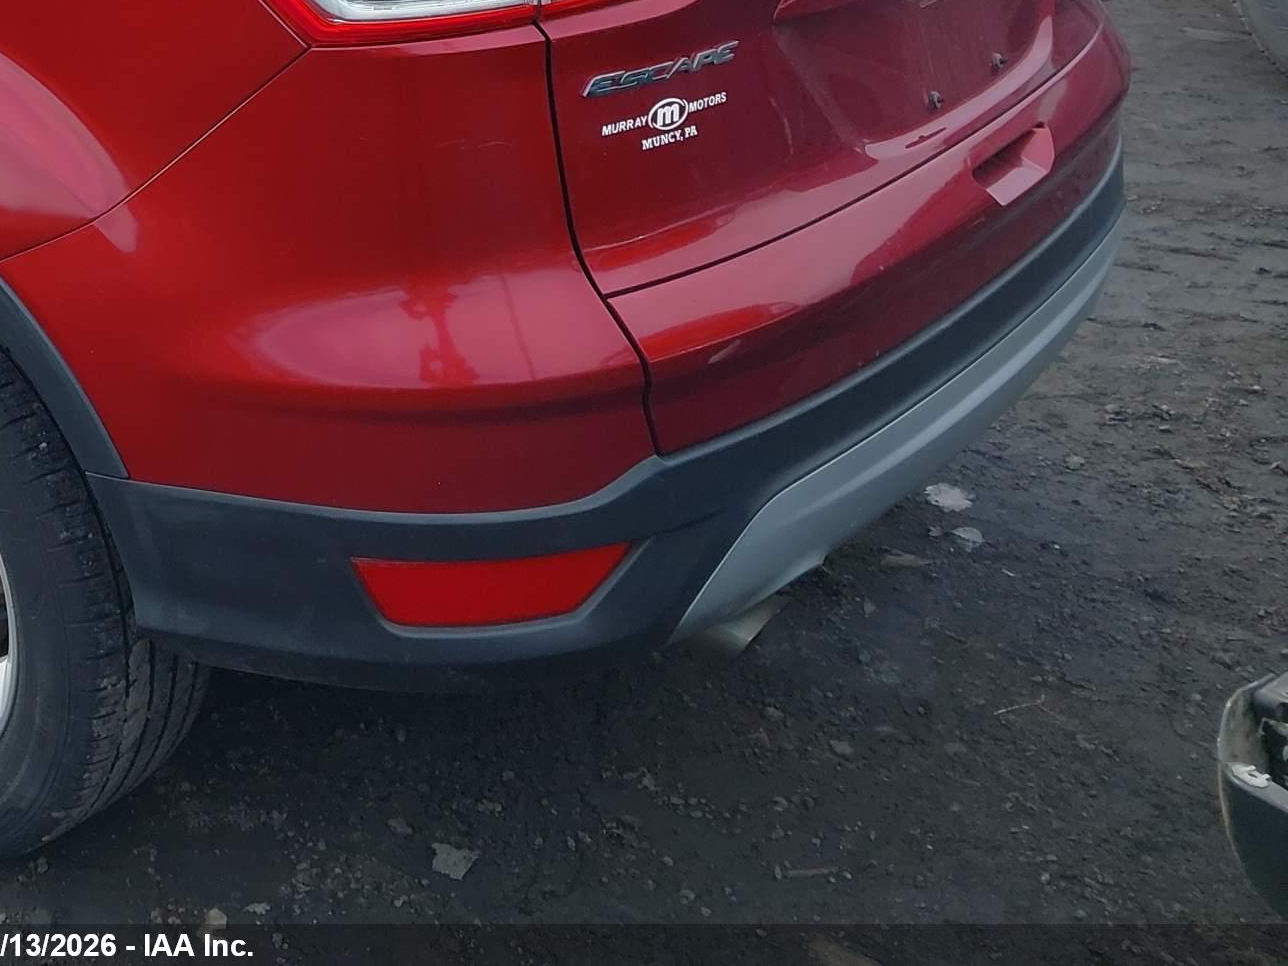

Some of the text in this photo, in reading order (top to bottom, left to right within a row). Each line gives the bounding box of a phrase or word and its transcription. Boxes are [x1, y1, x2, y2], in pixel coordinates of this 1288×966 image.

[582, 40, 740, 97] ESCAPE
[602, 115, 648, 136] MURRAY
[688, 92, 727, 113] MOTORS
[642, 125, 698, 150] MUNCY, PA
